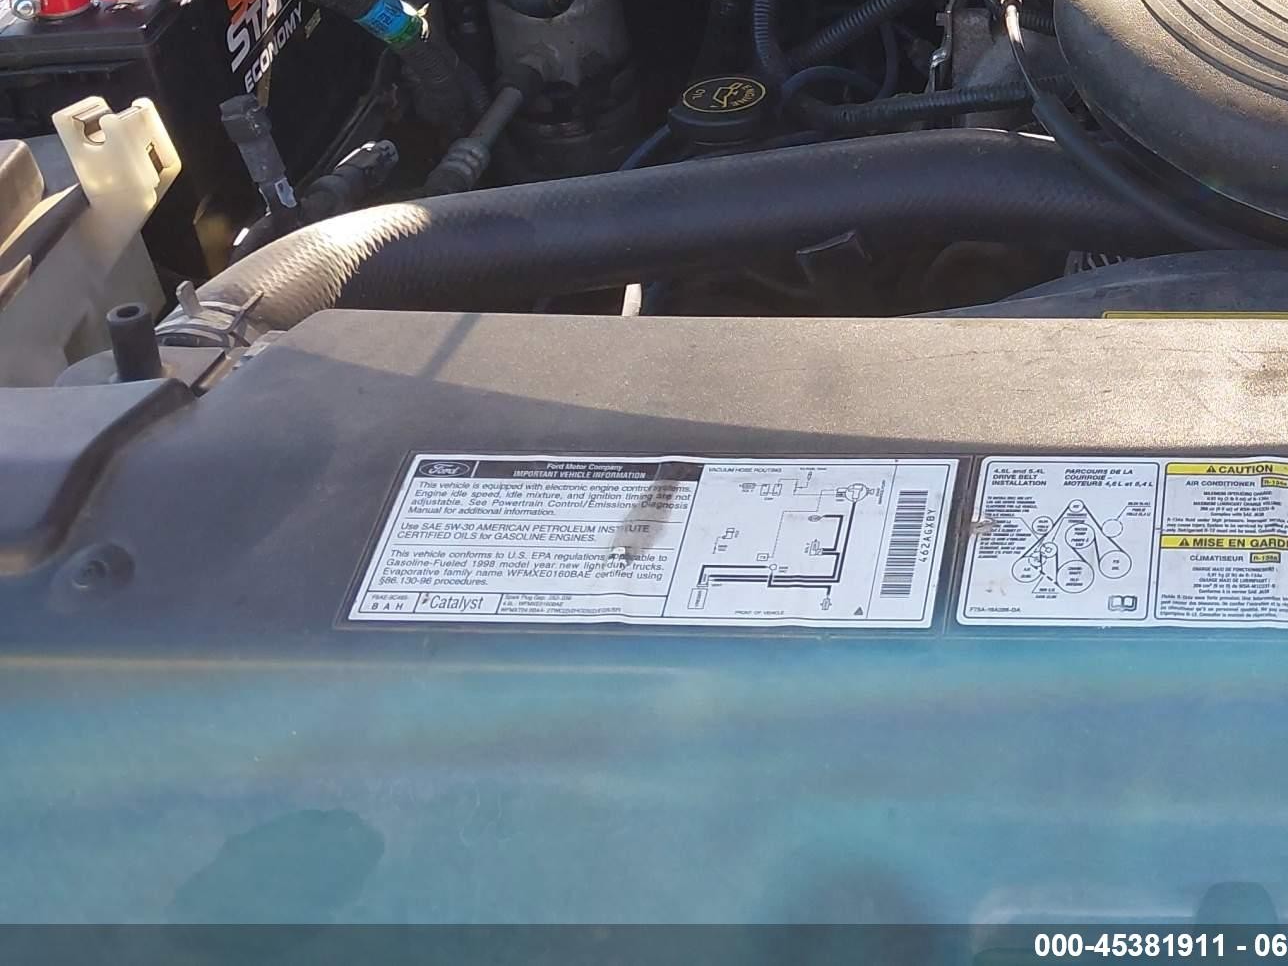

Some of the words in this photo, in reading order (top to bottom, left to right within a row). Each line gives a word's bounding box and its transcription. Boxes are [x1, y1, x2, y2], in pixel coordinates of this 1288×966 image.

[243, 1, 303, 94] ECONOMY
[428, 463, 461, 475] Ford
[588, 464, 624, 472] Company
[1218, 464, 1274, 474] CAUTION
[420, 481, 438, 489] This
[439, 482, 471, 490] vehicle
[472, 482, 480, 490] is
[482, 482, 524, 492] equipped
[526, 482, 544, 490] with
[544, 484, 588, 492] electronic
[589, 485, 620, 493] engine
[414, 490, 448, 498] Engine
[450, 490, 468, 498] idle
[505, 490, 522, 498] idle
[526, 491, 563, 500] mixture,
[566, 492, 586, 500] and
[588, 492, 622, 501] ignition
[625, 494, 654, 502] timing
[674, 494, 691, 502] not
[410, 498, 464, 506] adjustable.
[468, 498, 488, 506] See
[492, 499, 544, 508] Powertrain
[548, 500, 637, 508] Control/Emissions
[640, 501, 689, 510] Diagnosis
[408, 506, 442, 514] Manual
[444, 506, 456, 514] for
[458, 506, 502, 515] additional
[504, 508, 556, 516] information.
[400, 522, 419, 530] Use
[422, 522, 442, 530] SAE
[444, 523, 475, 531] 5W-30
[476, 523, 530, 532] AMERICAN
[532, 524, 596, 533] PETROLEUM
[396, 531, 451, 540] CERTIFIED
[453, 532, 478, 540] OILS
[479, 532, 493, 540] for
[494, 532, 547, 541] GASOLINE
[552, 534, 596, 542] ENGINES.
[1192, 538, 1225, 548] MISE
[1228, 538, 1246, 548] EN
[390, 549, 410, 558] This
[413, 550, 446, 558] vehicle
[448, 550, 492, 558] conforms
[494, 551, 505, 559] to
[508, 551, 528, 560] U.S.
[531, 552, 551, 560] EPA
[554, 552, 608, 562] regulations
[658, 554, 668, 562] to
[1190, 554, 1244, 562] CLIMATISEUR
[386, 558, 467, 568] Gasoline-Fueled
[472, 560, 496, 568] 1998
[498, 560, 530, 568] model
[534, 562, 554, 570] year
[559, 562, 580, 570] new
[632, 563, 665, 571] trucks.
[382, 568, 440, 576] Evaporative
[443, 568, 472, 578] family
[594, 570, 633, 579] certified
[636, 572, 663, 582] using
[434, 578, 489, 586] procedures.
[429, 594, 484, 612] Catalyst
